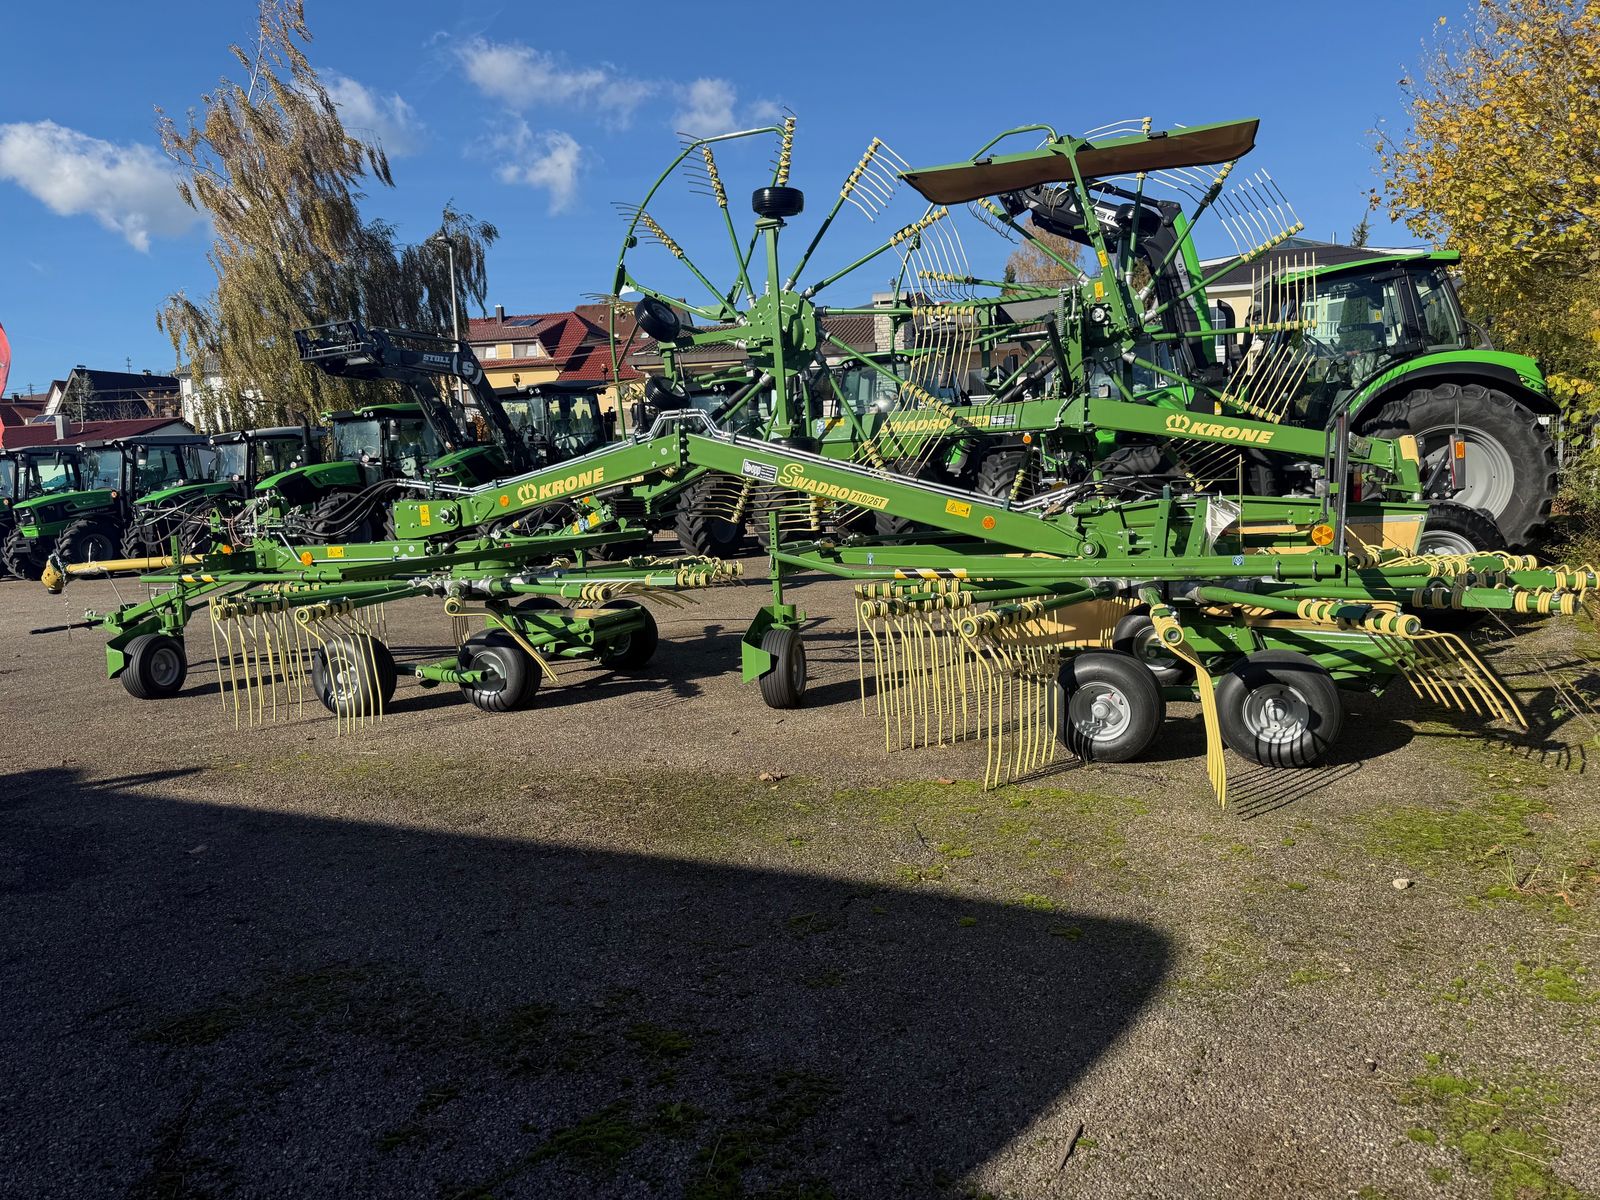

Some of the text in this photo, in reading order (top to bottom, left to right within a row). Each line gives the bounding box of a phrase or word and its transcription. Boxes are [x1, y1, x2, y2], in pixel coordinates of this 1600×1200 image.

[423, 353, 450, 364] STOLL
[1188, 422, 1275, 444] KRONE
[539, 467, 604, 499] KRONE
[850, 491, 887, 508] 710/26T
